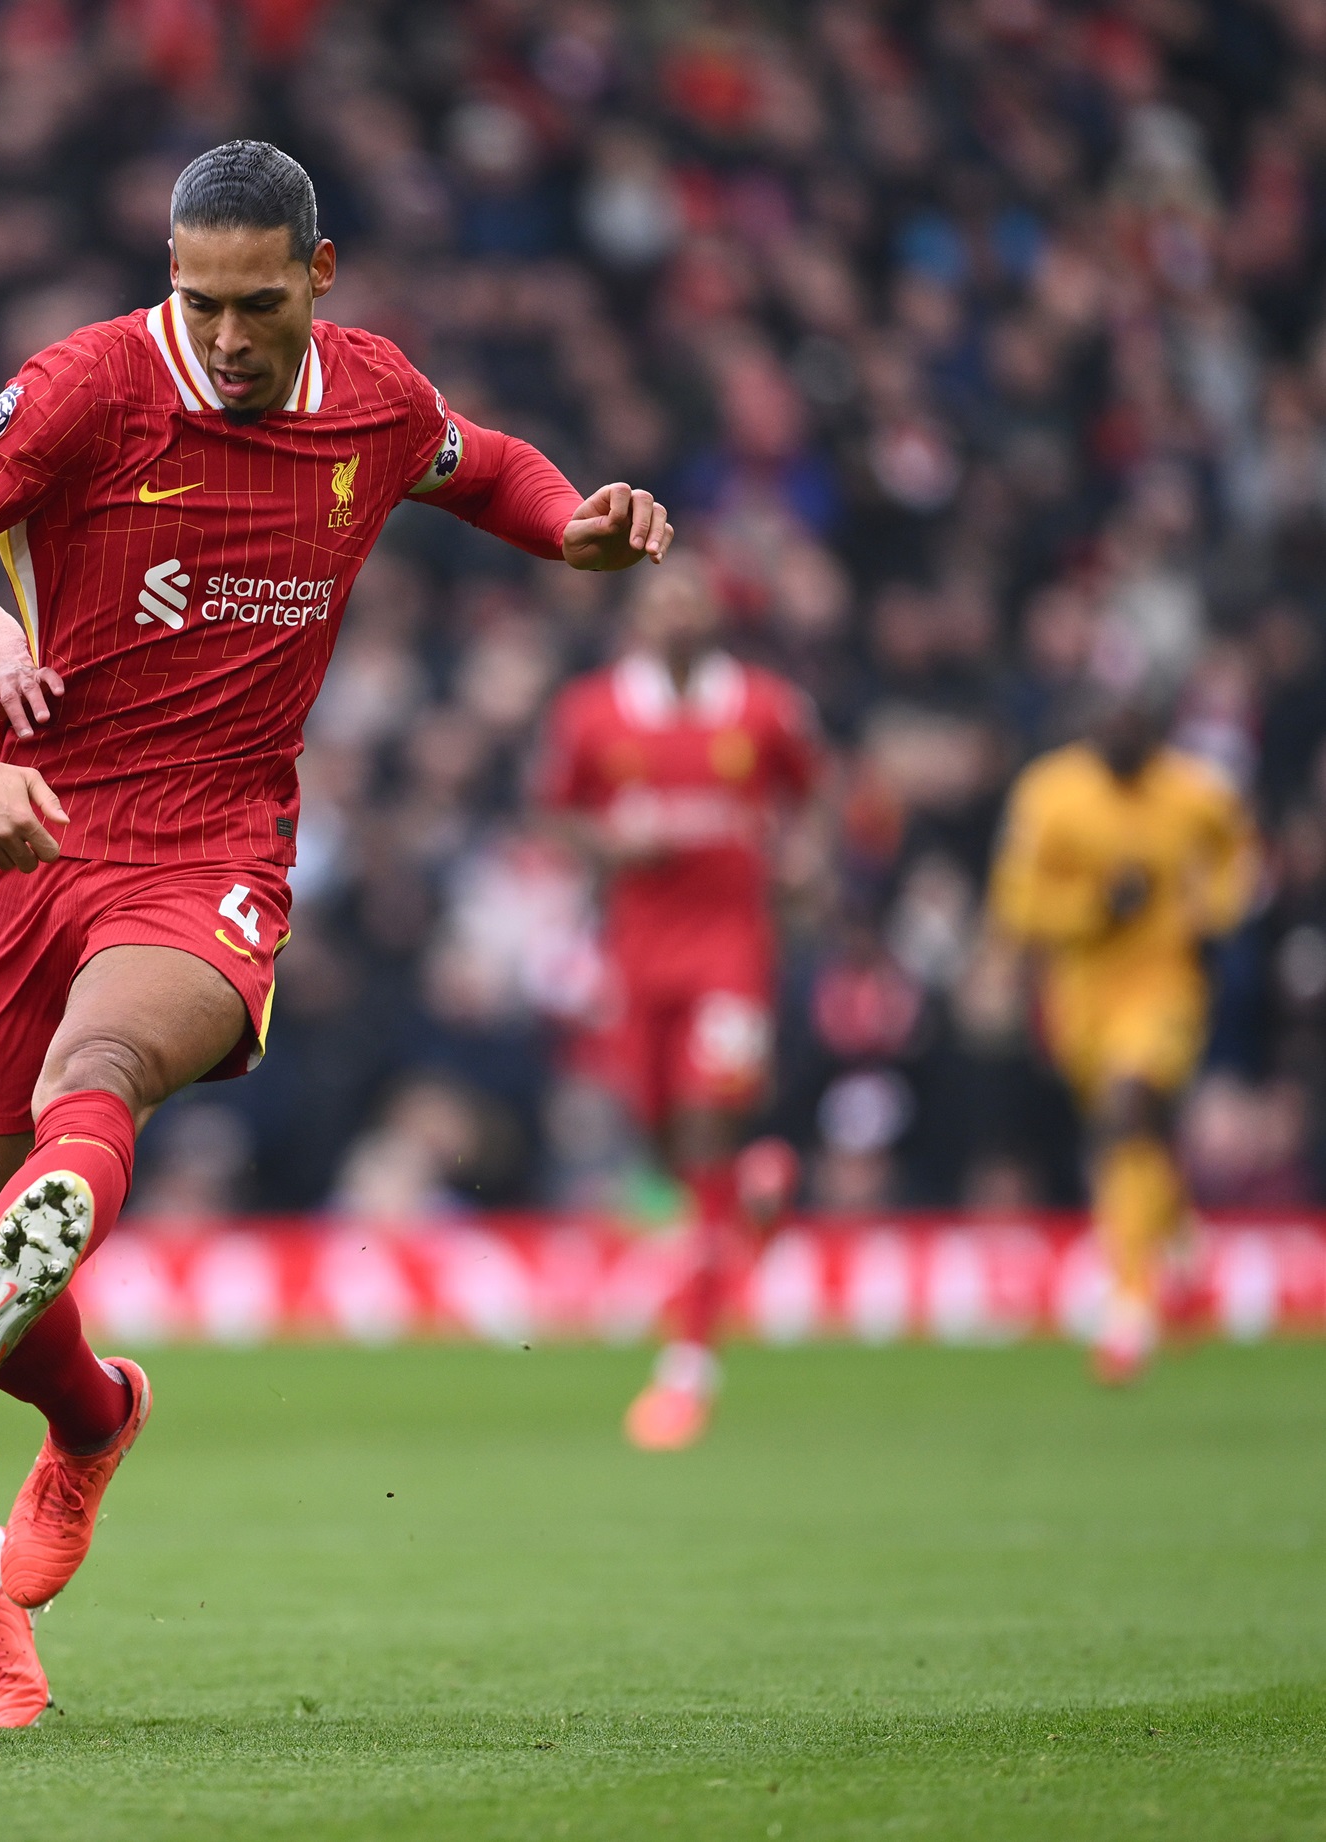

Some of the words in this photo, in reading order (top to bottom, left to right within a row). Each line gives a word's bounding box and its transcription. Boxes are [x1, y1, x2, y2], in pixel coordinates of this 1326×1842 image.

[205, 572, 338, 601] standard
[201, 597, 330, 627] chartered
[218, 883, 260, 947] 4
